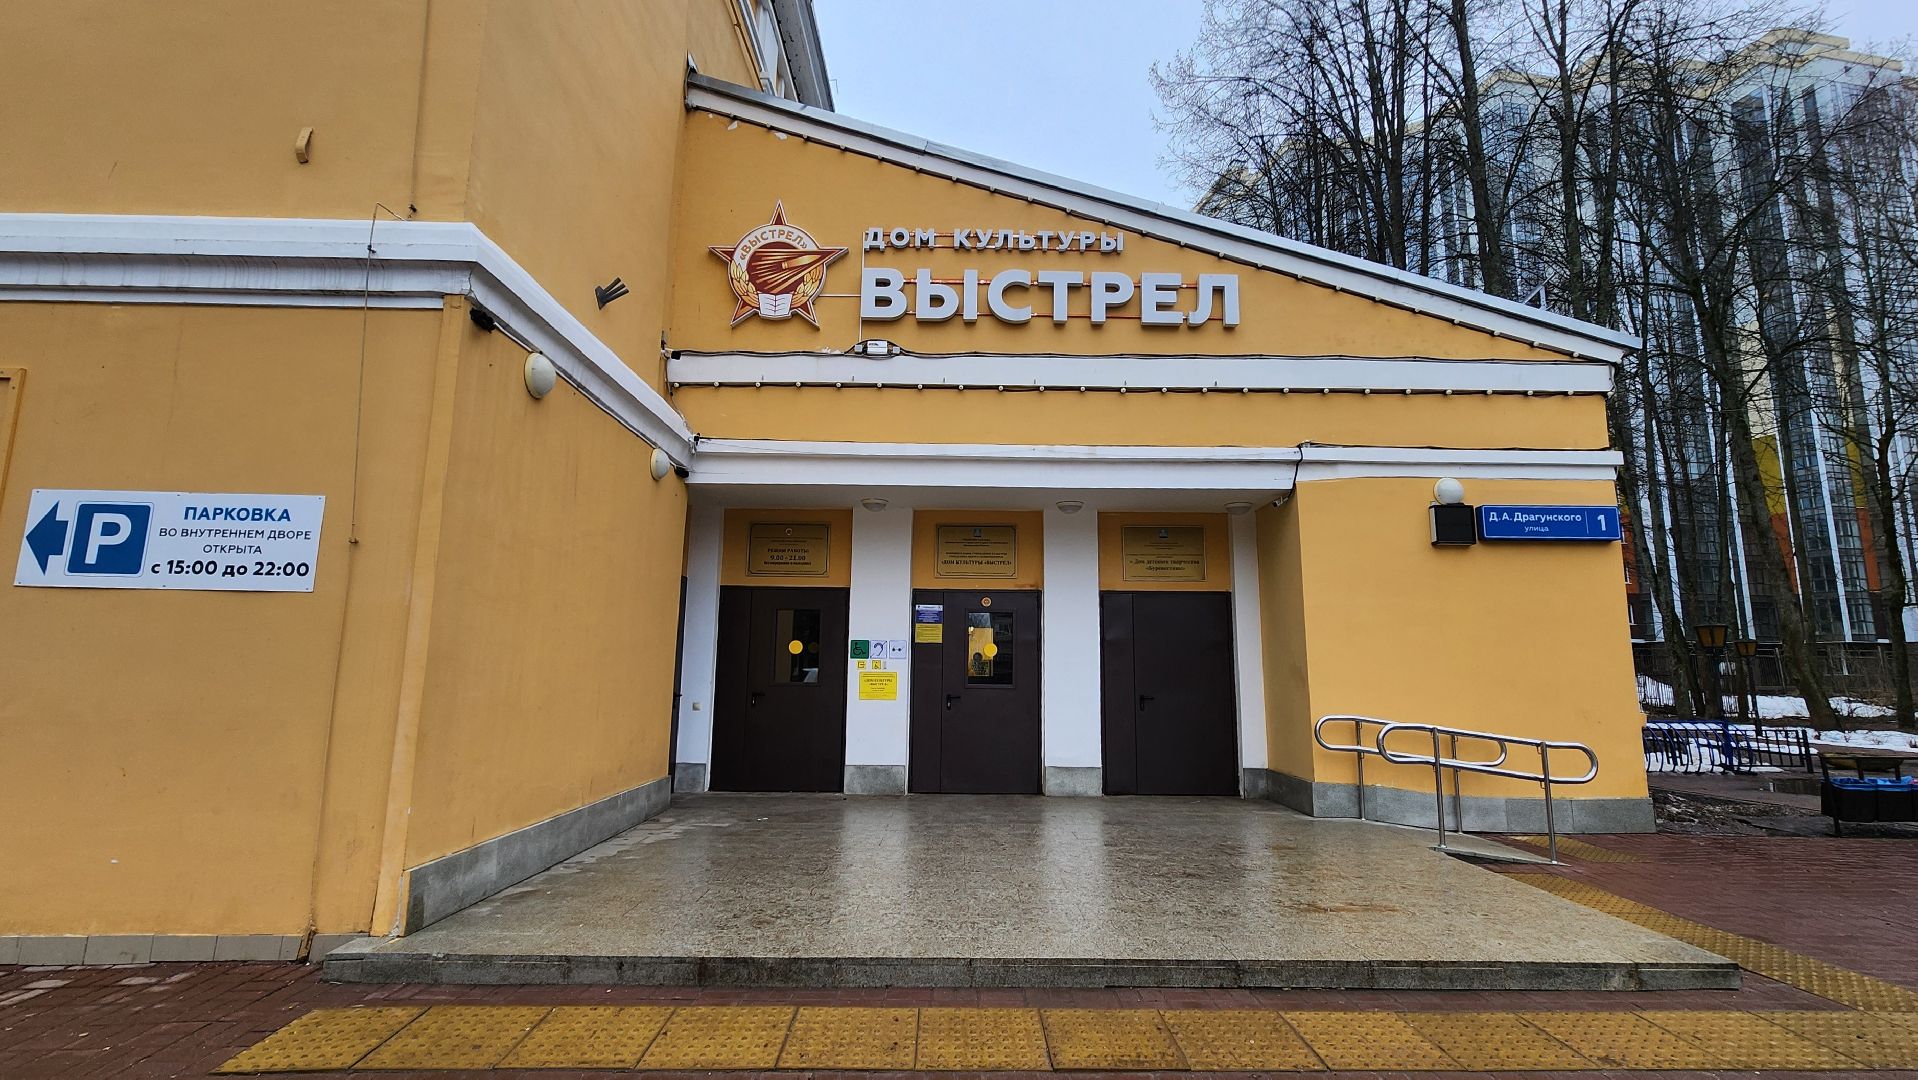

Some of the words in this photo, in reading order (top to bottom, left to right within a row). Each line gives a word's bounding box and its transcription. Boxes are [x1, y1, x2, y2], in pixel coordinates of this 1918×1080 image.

[739, 229, 808, 261] «ВЫСТРЕЛ»
[864, 227, 936, 252] ДОМ
[953, 229, 1124, 254] КУЛЬТУРЫ
[861, 267, 1240, 328] ВЫСТРЕЛ
[183, 507, 291, 522] ПАРКОВКА
[1597, 514, 1607, 531] 1
[159, 528, 178, 537] ВО
[181, 528, 265, 539] ВНУТРЕННЕМ
[267, 530, 312, 541] ДВОРЕ
[1524, 525, 1549, 533] улица
[202, 544, 263, 555] ОТКРЫТА
[166, 560, 218, 576] 15:00
[222, 564, 248, 578] до
[252, 562, 310, 577] 22:00
